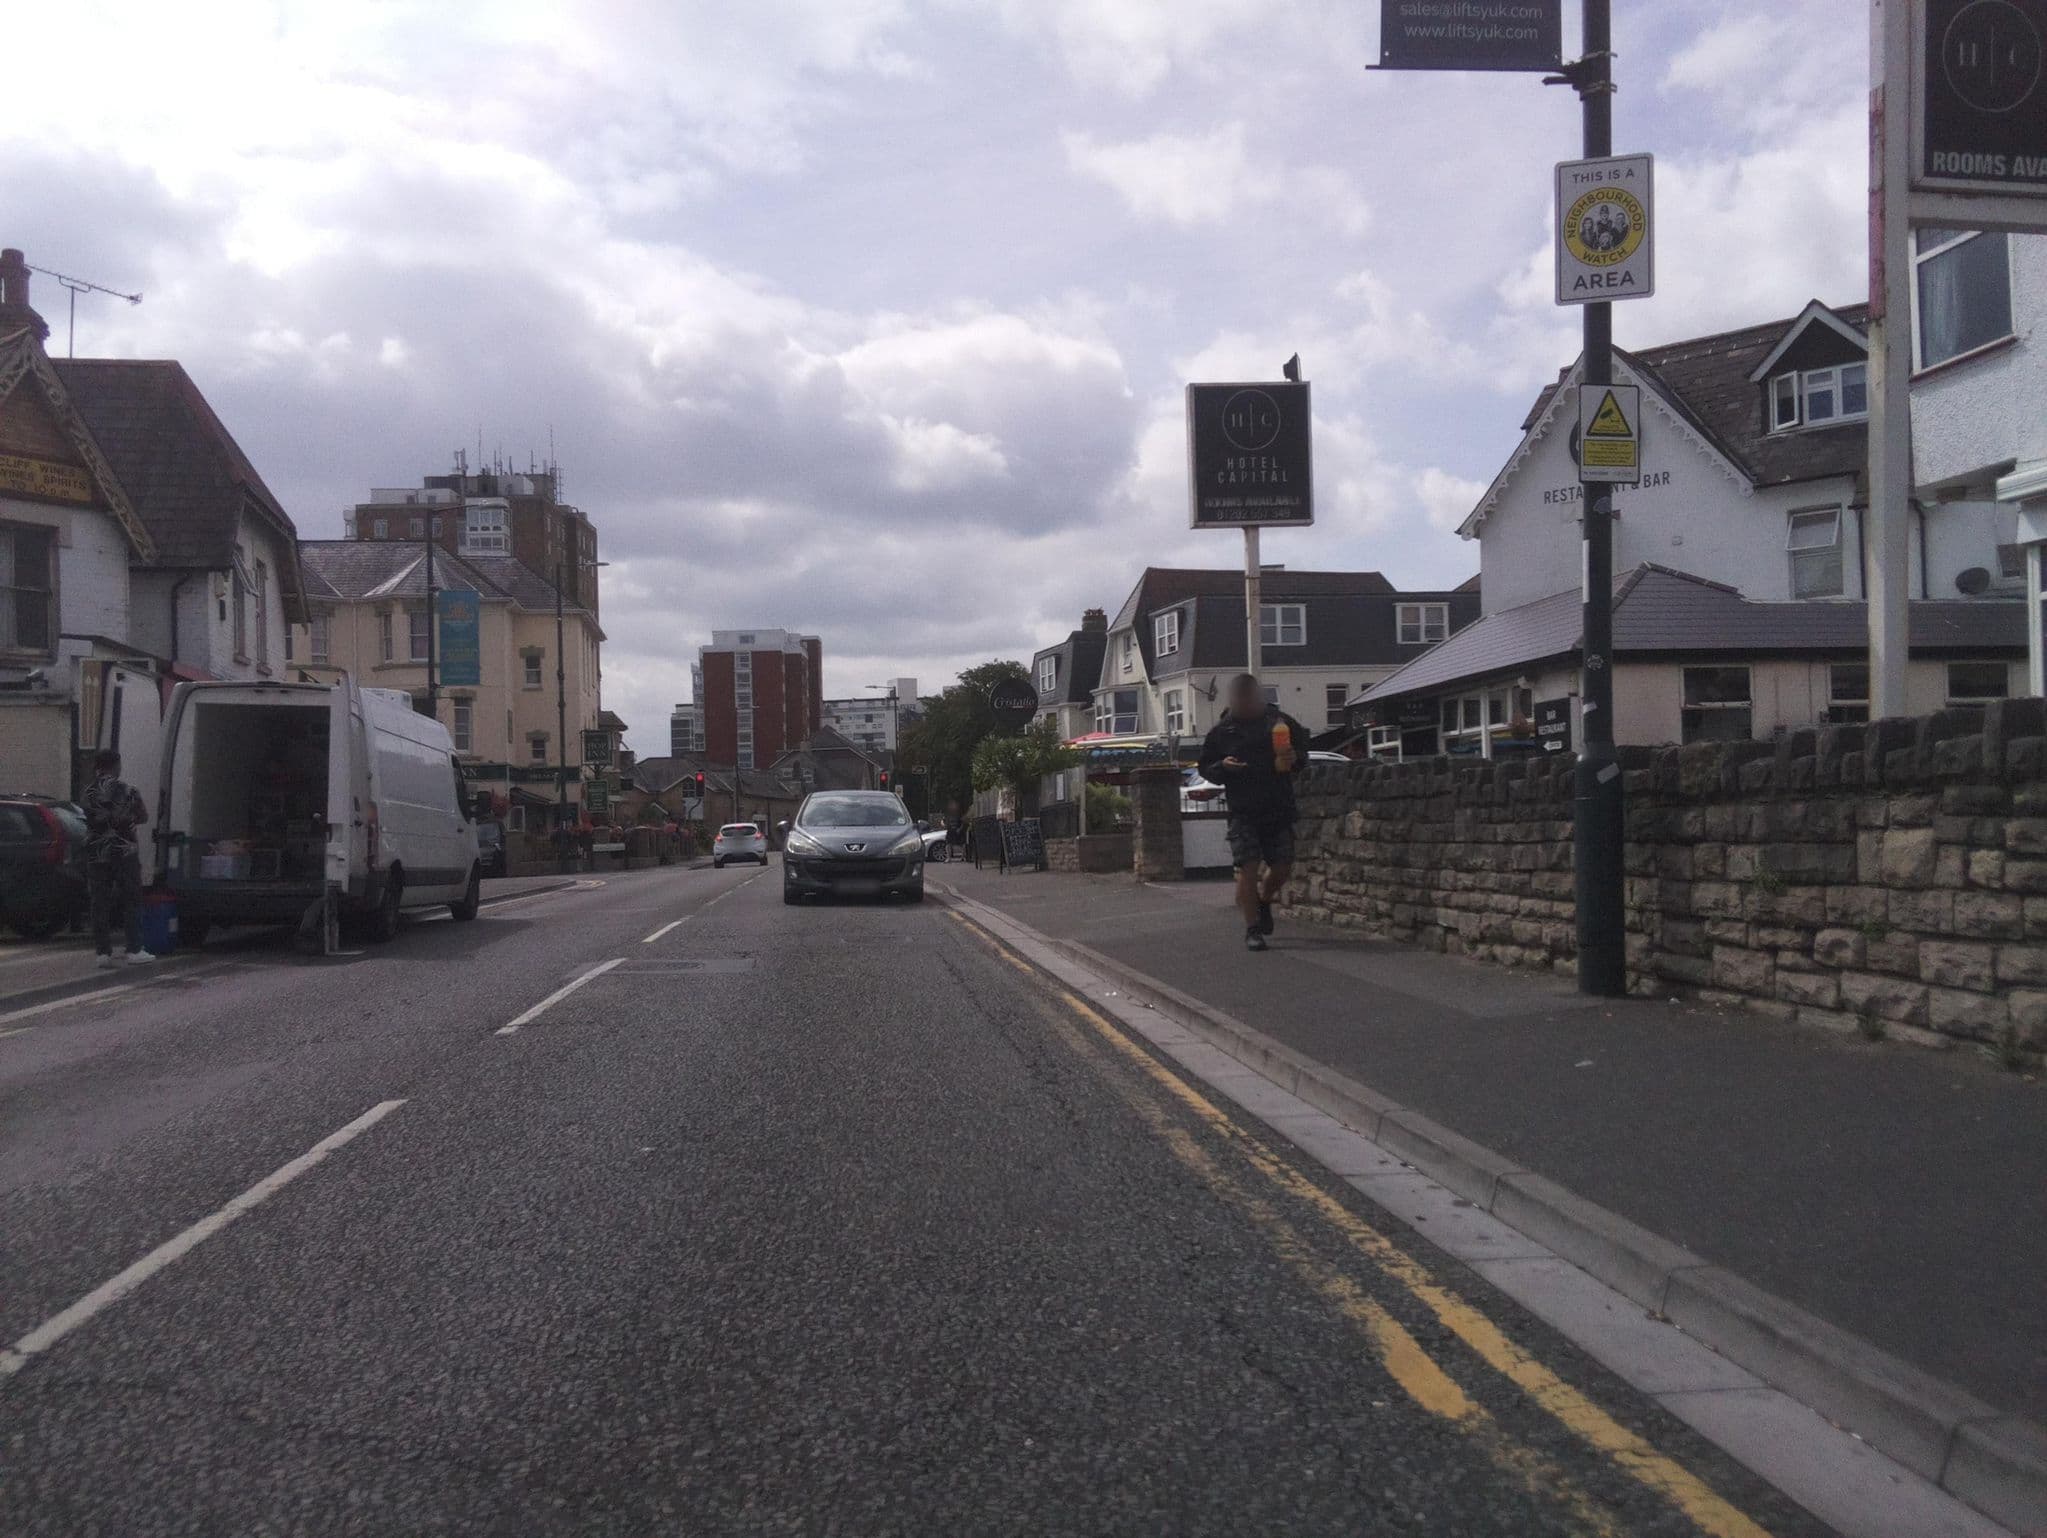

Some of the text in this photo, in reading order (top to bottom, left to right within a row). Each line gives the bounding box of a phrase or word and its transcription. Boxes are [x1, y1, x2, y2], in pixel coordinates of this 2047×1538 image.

[1400, 1, 1543, 20] sales@liftsyuk.com
[1405, 23, 1538, 41] www.liftsyuk.com
[1933, 151, 2007, 176] ROOMS
[1572, 167, 1635, 184] THIS IS A
[1567, 190, 1643, 239] NEIGHBOURHOOD
[1582, 248, 1626, 265] WATCH
[1573, 270, 1635, 291] AREA
[1226, 456, 1280, 470] HOTEL
[1217, 470, 1288, 484] CAPITAL
[1643, 471, 1670, 488] BAR
